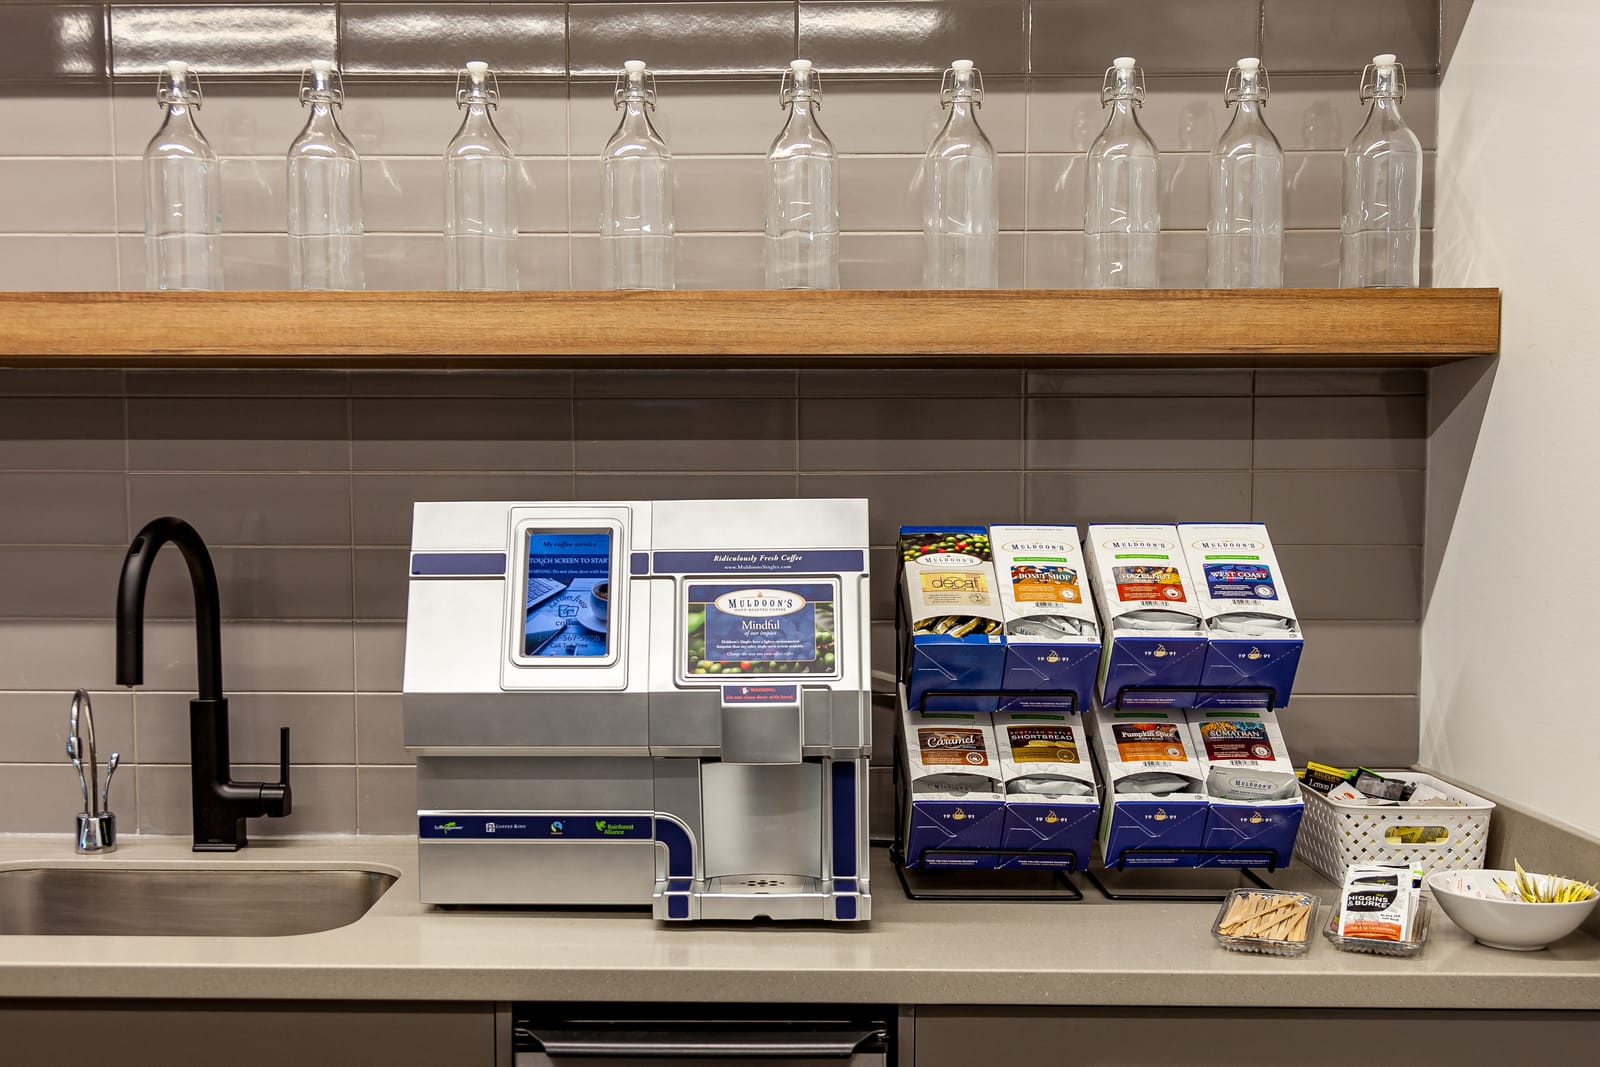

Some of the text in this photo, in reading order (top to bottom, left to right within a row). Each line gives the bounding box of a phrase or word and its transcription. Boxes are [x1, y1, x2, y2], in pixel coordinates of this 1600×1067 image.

[713, 554, 758, 563] Ridiculously
[781, 554, 803, 562] Coffee
[932, 576, 978, 589] decaf
[728, 598, 793, 609] MULDOON'S
[742, 620, 780, 630] Mindful
[928, 735, 975, 748] Caramel
[1309, 778, 1329, 790] Lemon
